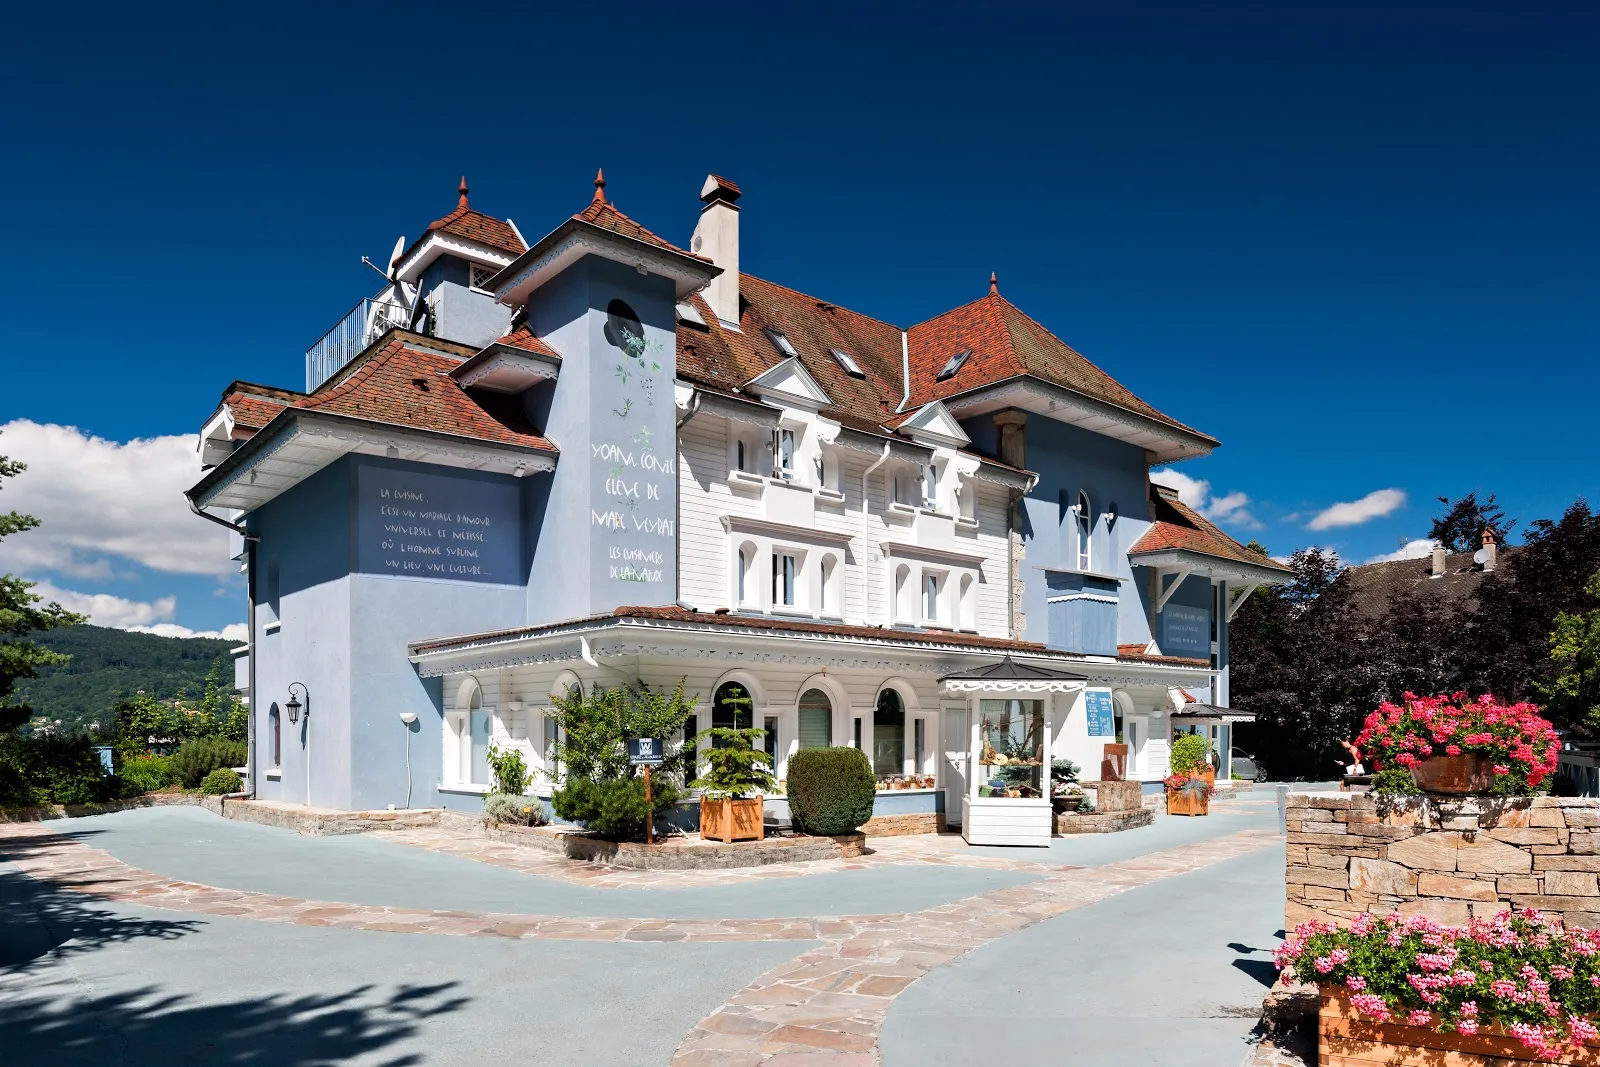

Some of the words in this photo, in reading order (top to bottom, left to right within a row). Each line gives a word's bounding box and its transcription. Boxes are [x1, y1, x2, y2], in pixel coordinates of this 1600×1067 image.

[380, 488, 390, 498] LA
[647, 482, 660, 501] DE
[419, 511, 452, 522] MARIAGE
[591, 508, 626, 530] MARC
[632, 514, 674, 538] VEYRAT
[437, 528, 446, 538] ET
[446, 545, 480, 559] SUBLIME
[609, 545, 622, 560] LES
[623, 547, 664, 565] CUISINIERS
[385, 559, 400, 568] UN
[426, 562, 446, 573] UNE
[610, 564, 619, 579] DE
